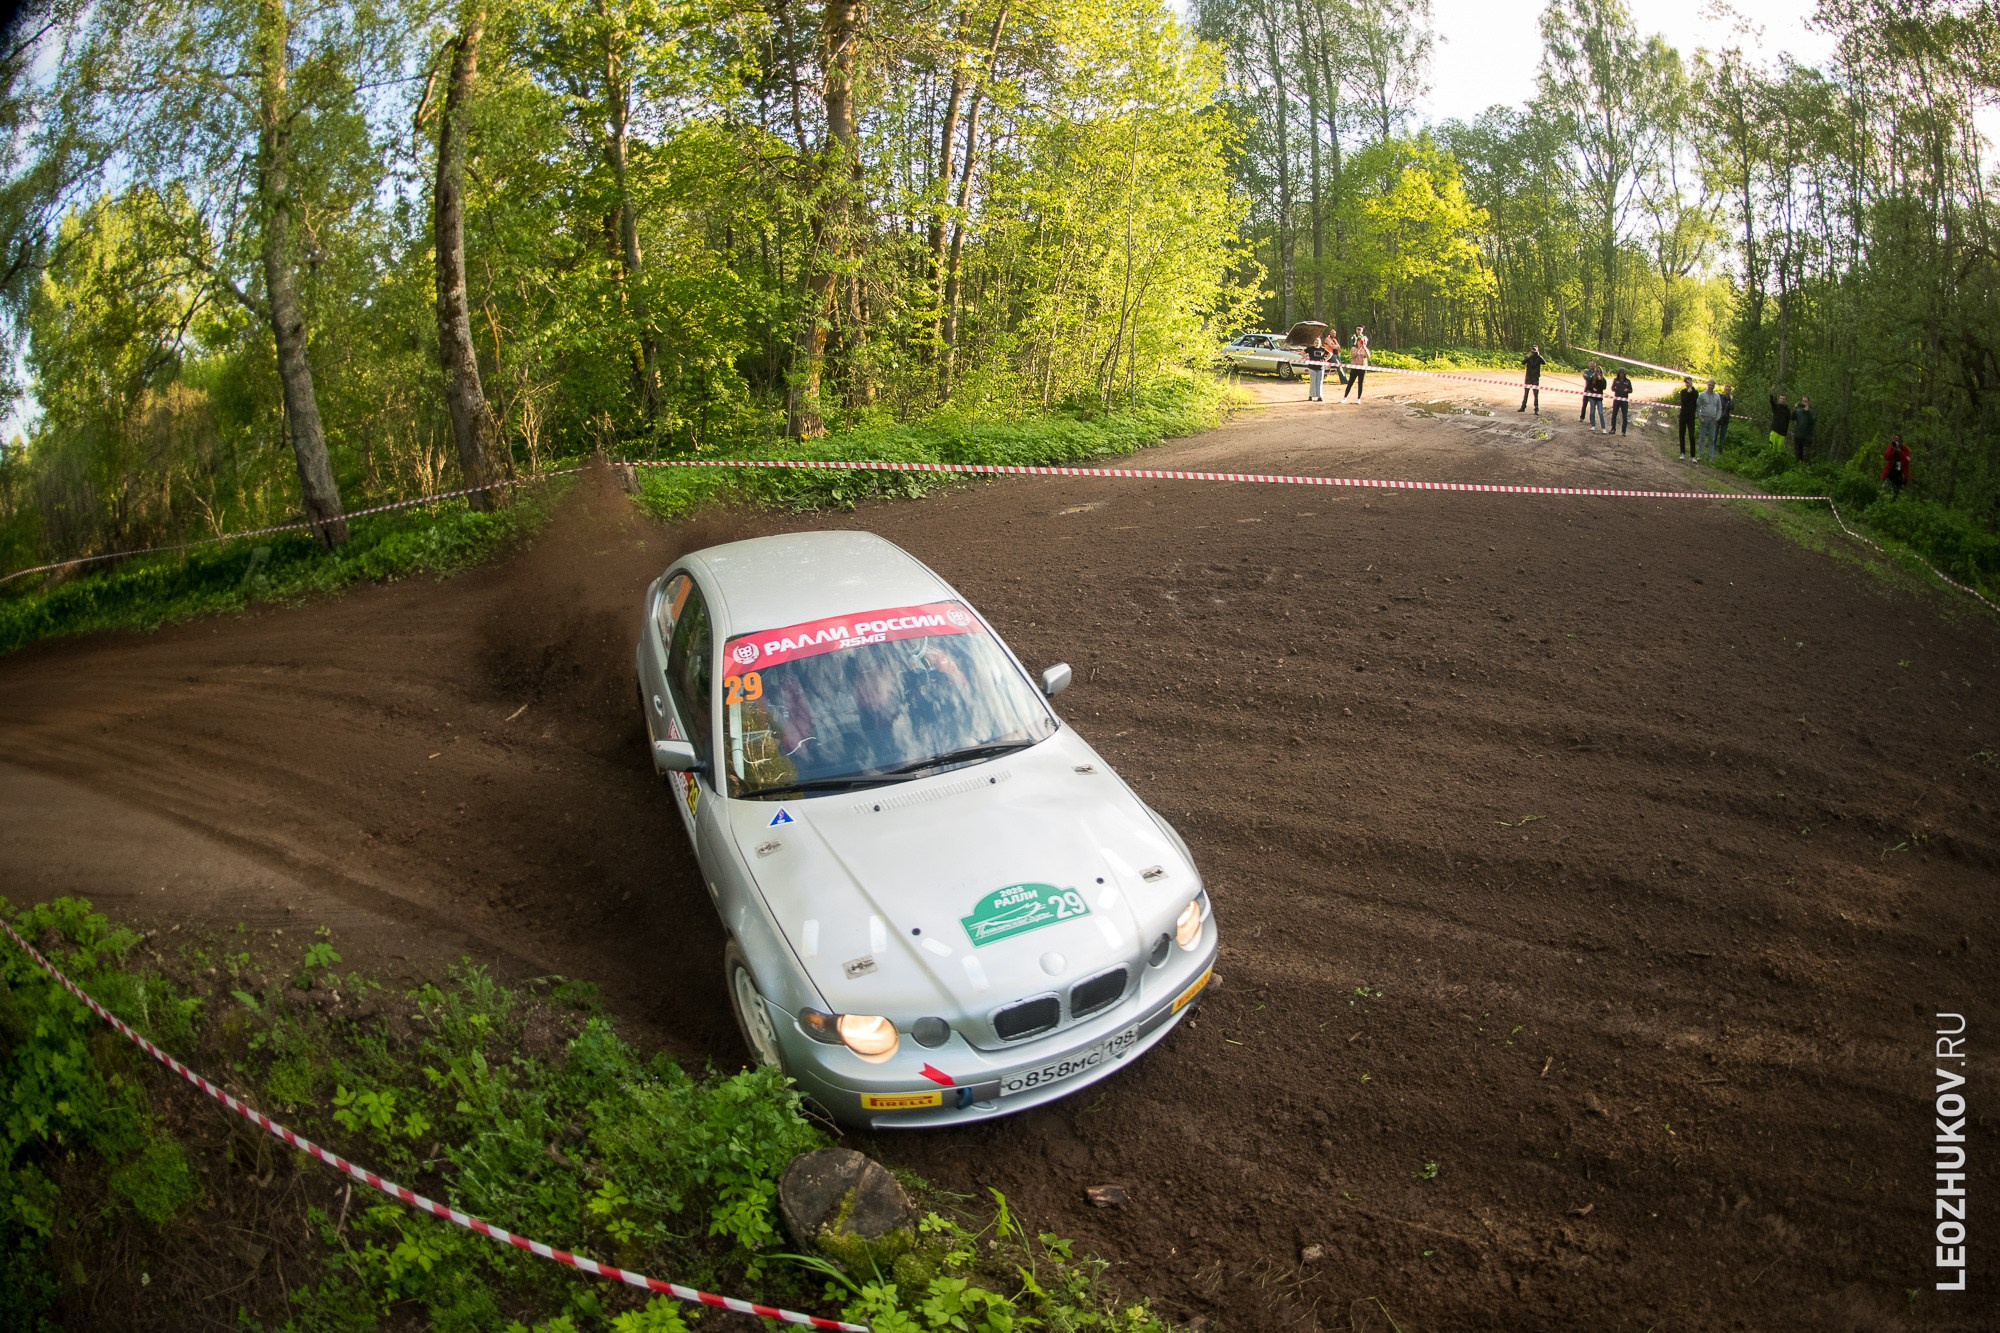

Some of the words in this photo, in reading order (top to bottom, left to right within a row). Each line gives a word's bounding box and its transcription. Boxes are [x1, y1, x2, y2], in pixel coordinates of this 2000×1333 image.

[763, 625, 850, 656] РАЛЛИ
[854, 614, 946, 636] РОССИИ
[724, 672, 763, 705] 29
[994, 890, 1038, 908] РАЛЛИ
[1048, 892, 1087, 919] 29
[870, 1095, 933, 1107] PIRELLI
